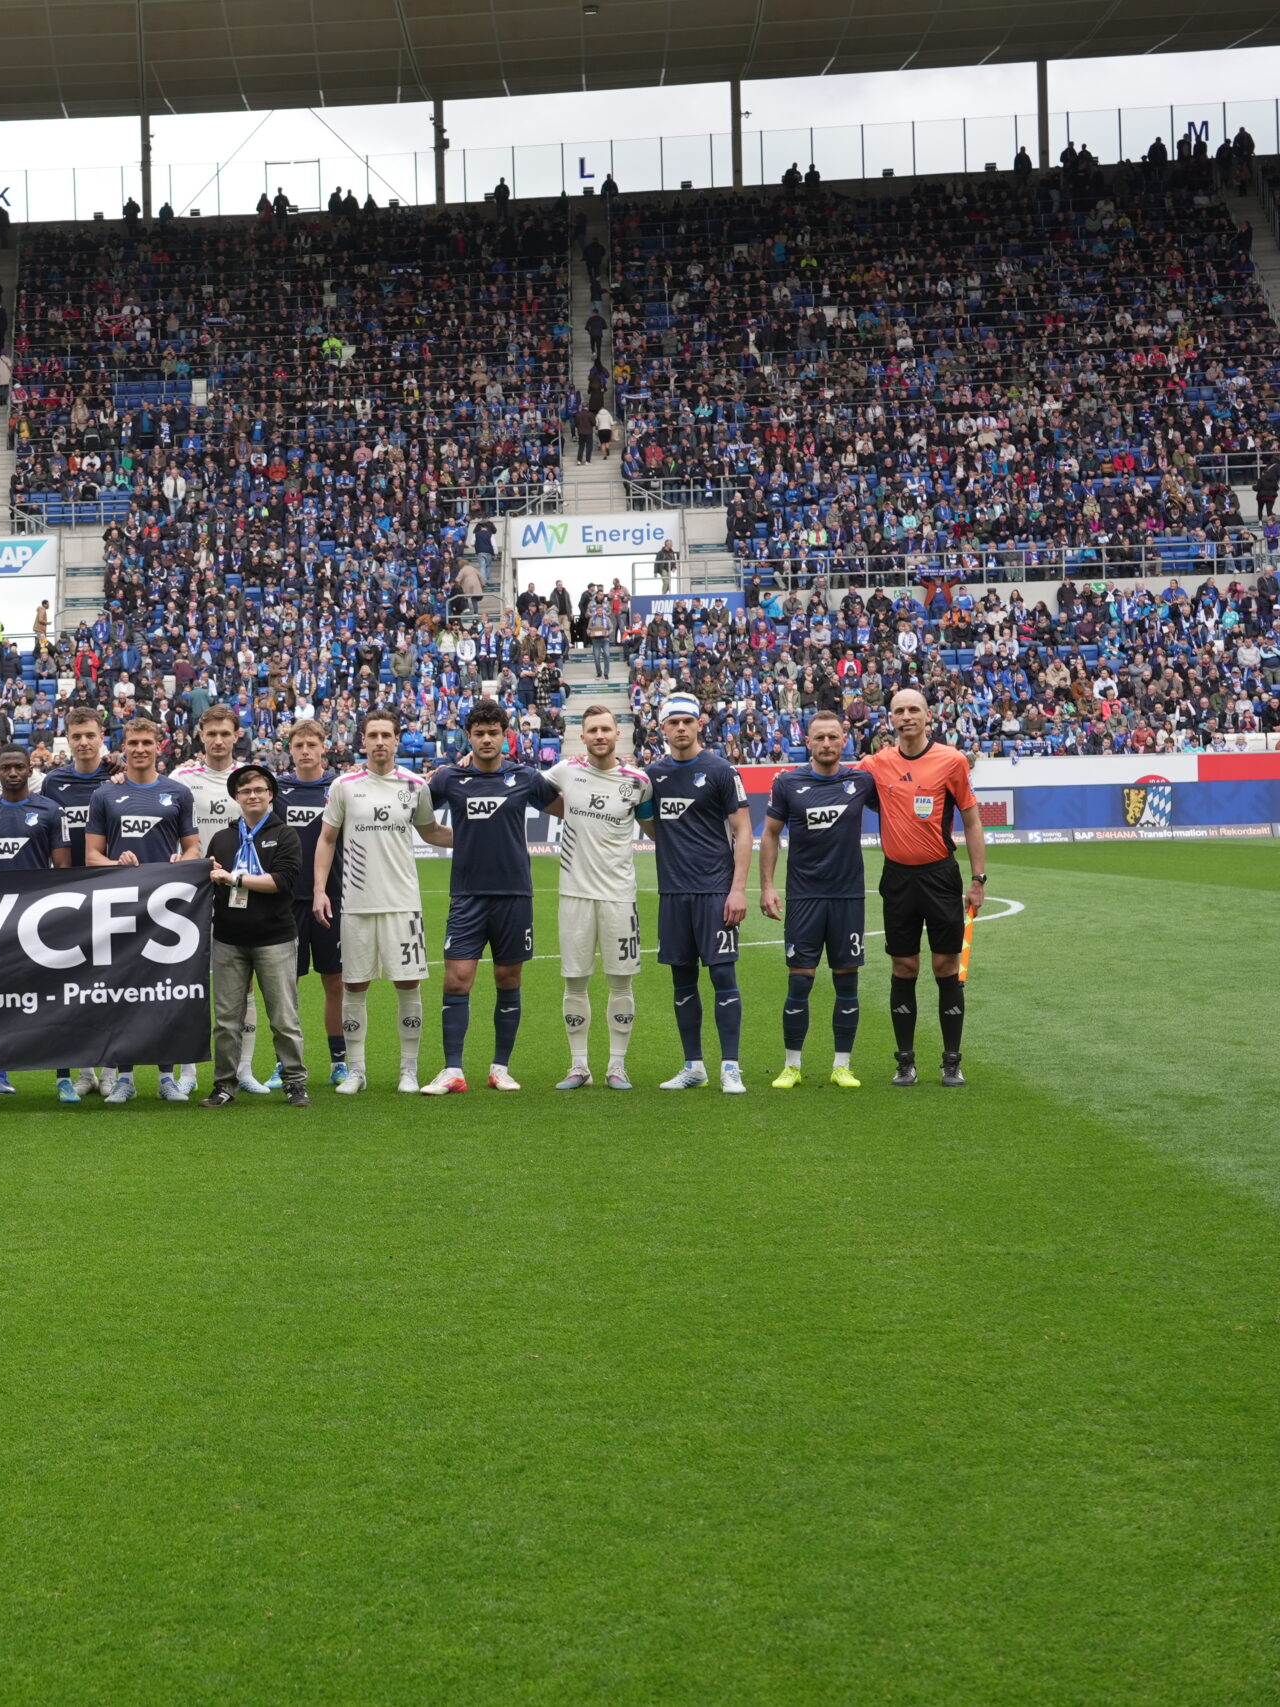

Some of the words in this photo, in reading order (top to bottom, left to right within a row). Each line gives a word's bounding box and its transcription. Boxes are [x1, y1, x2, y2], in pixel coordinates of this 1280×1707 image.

[1187, 121, 1209, 142] M
[579, 157, 595, 179] L
[581, 523, 665, 546] Energie
[287, 808, 316, 822] SAP
[467, 801, 498, 815] SAP
[569, 806, 621, 825] Kömmerling
[661, 802, 686, 816] SAP
[807, 810, 838, 825] SAP
[122, 819, 151, 834] SAP
[196, 815, 234, 825] ömmerli
[354, 823, 406, 833] Kömmerling
[1075, 831, 1094, 840] SAP
[1138, 829, 1207, 838] Transformation
[1209, 828, 1218, 836] in
[1220, 827, 1271, 836] Rekordzeit!
[524, 928, 532, 950] 5
[716, 930, 736, 954] 21
[400, 942, 420, 966] 31
[618, 938, 637, 961] 30
[63, 978, 205, 1006] Prävention
